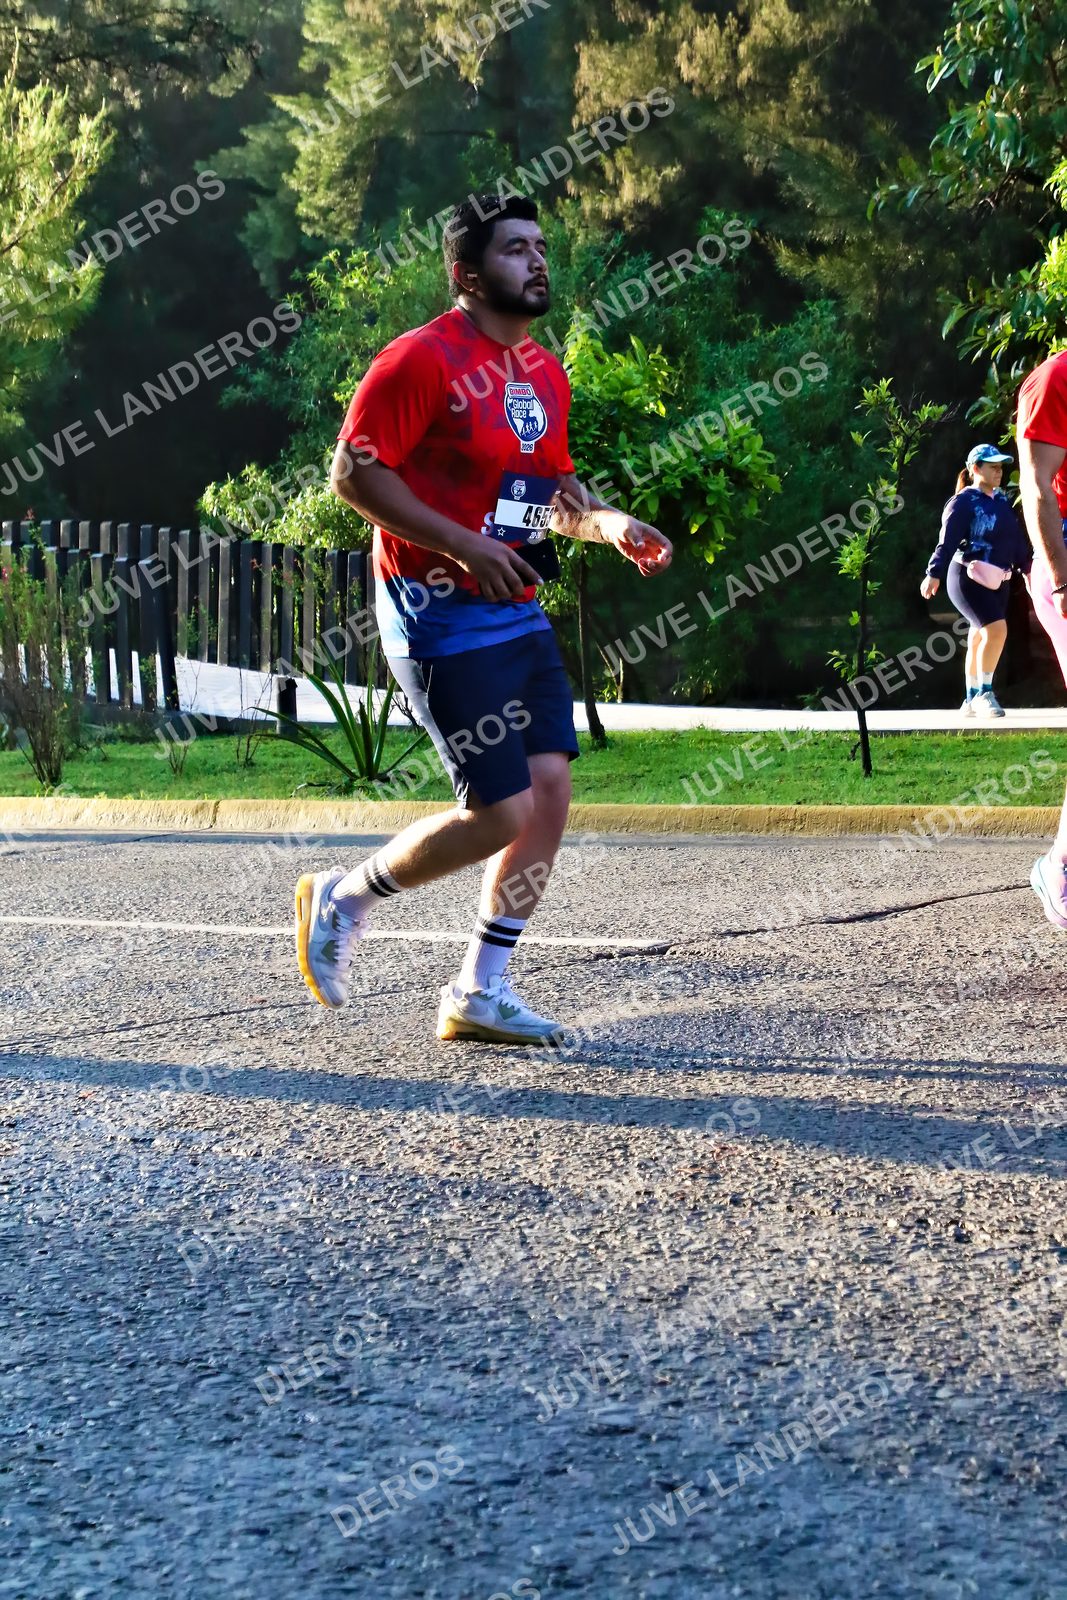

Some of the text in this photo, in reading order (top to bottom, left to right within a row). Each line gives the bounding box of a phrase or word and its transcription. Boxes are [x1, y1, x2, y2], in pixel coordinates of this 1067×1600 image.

[509, 388, 531, 396] BIMBO
[512, 399, 533, 409] Global
[511, 408, 527, 419] Race
